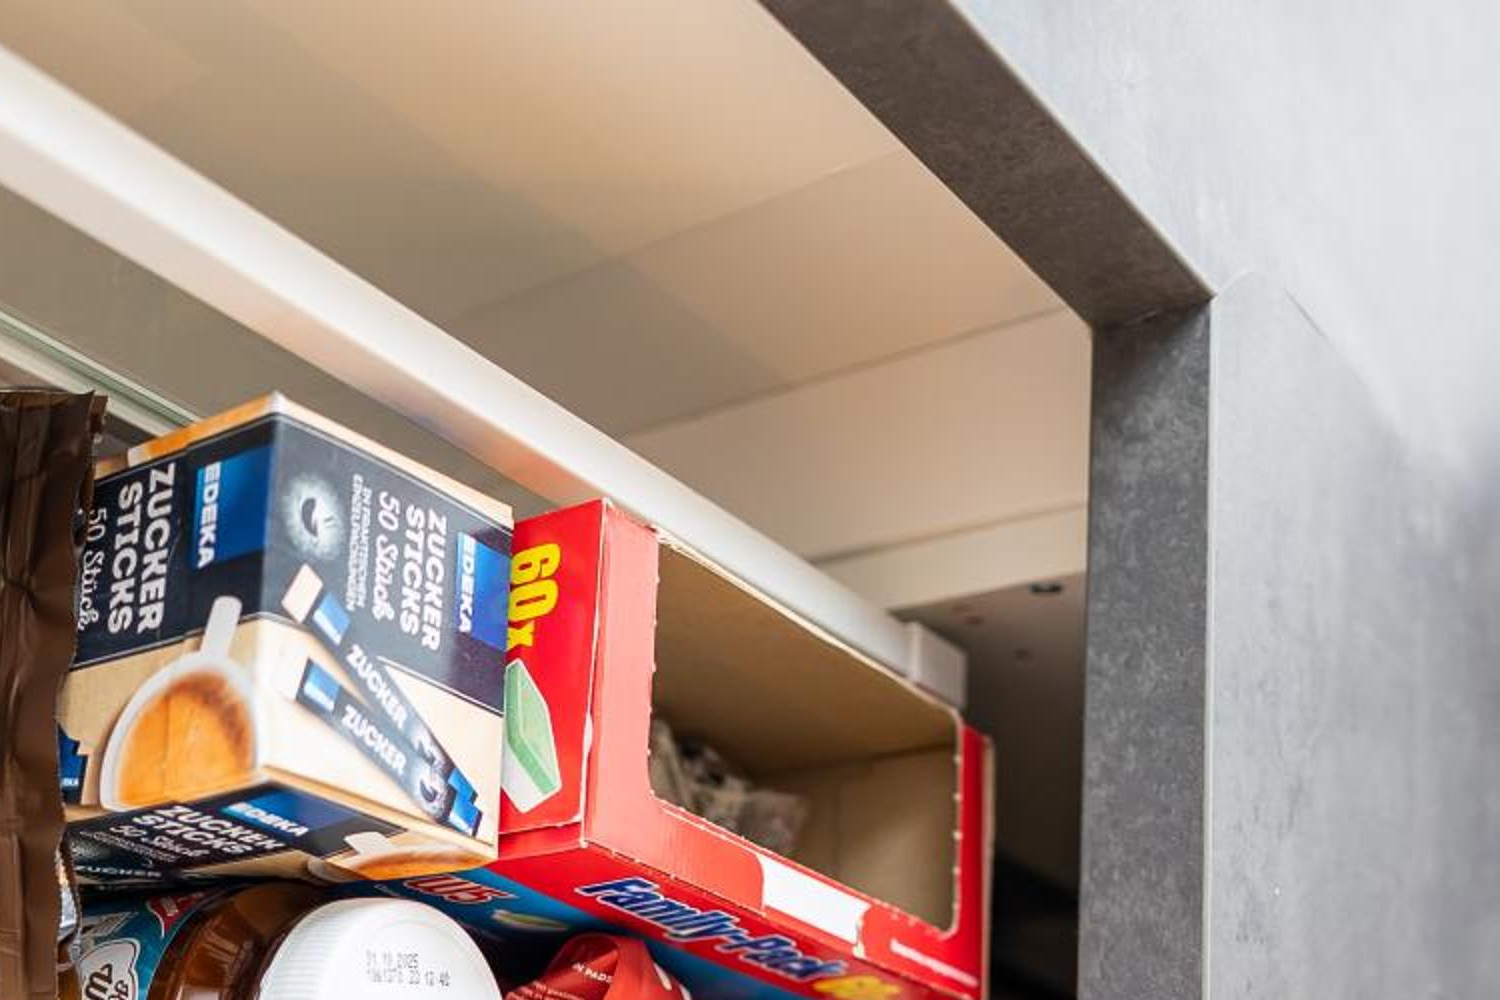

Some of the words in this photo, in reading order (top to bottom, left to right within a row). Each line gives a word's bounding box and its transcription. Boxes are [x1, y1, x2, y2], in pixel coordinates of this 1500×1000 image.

[86, 507, 107, 542] 50
[137, 462, 175, 634] ZUCKER
[197, 461, 222, 569] EDEKA
[377, 491, 401, 532] 50
[77, 550, 105, 632] Stück
[107, 481, 143, 634] STICKS
[371, 534, 399, 621] Stück
[399, 503, 426, 635] STICKS
[421, 508, 448, 652] ZUCKER
[457, 533, 477, 633] EDEKA
[346, 643, 408, 731] ZUCKER
[341, 704, 406, 776] ZUCKER
[131, 815, 254, 854] STICKS
[152, 805, 287, 851] ZUCKER
[227, 801, 309, 837] EDEKA
